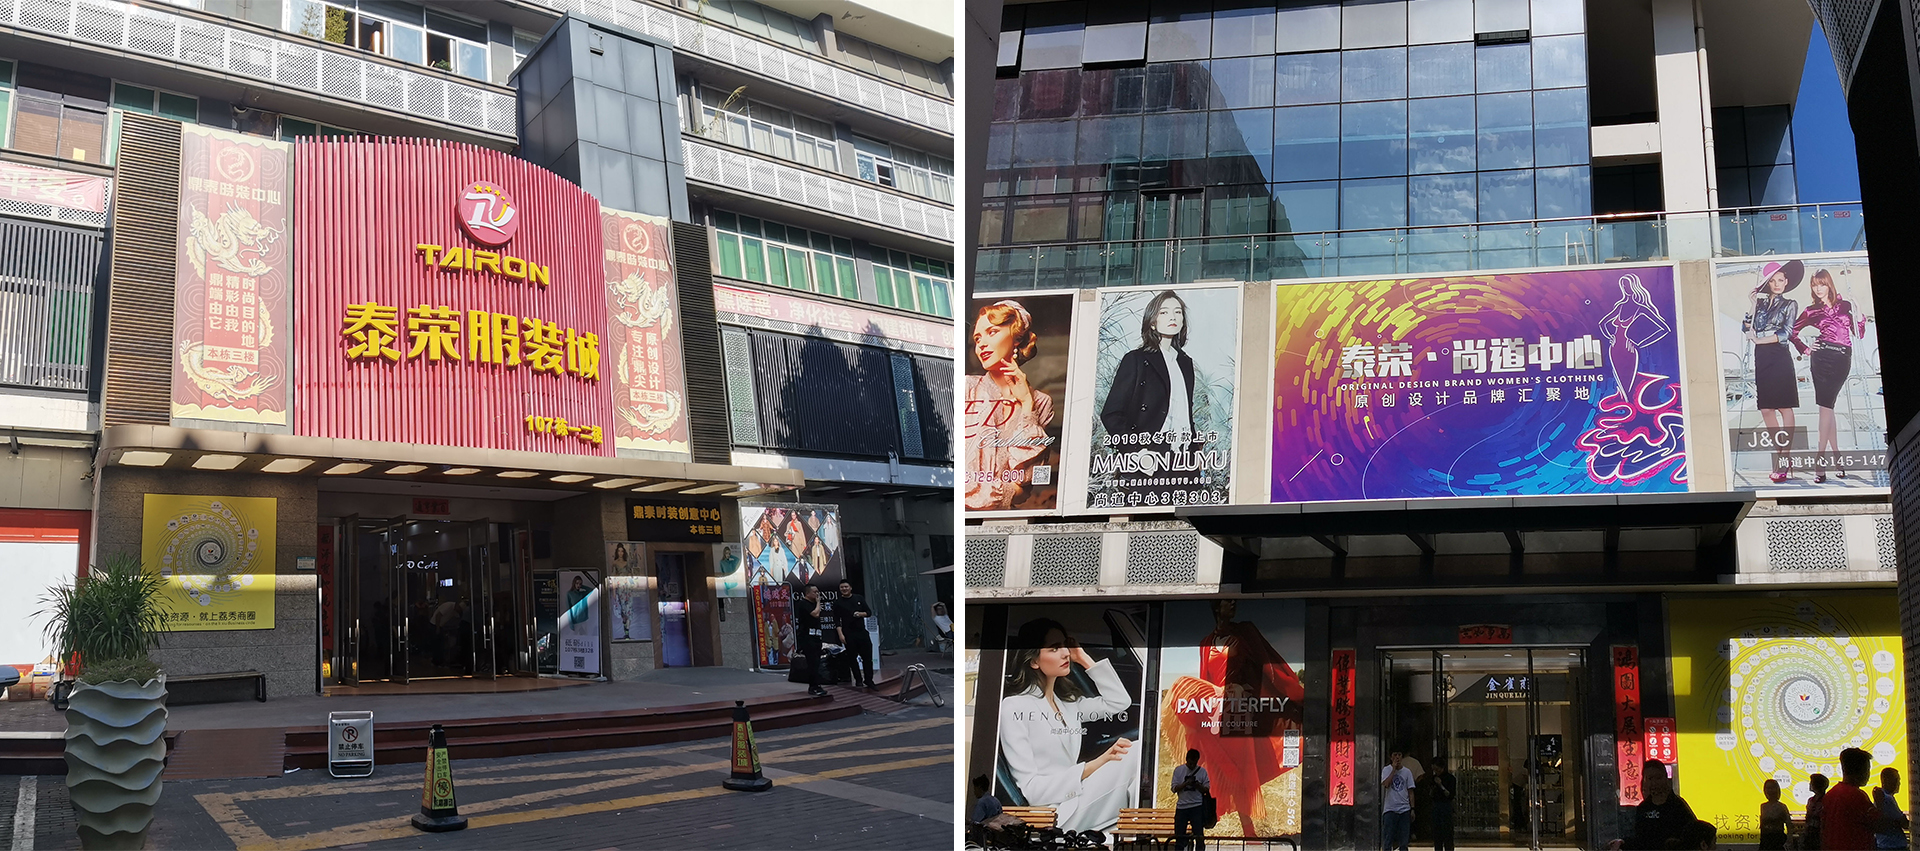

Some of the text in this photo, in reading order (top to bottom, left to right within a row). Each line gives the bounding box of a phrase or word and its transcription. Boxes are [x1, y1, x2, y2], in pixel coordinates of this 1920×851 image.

[416, 243, 549, 287] TAIRON
[208, 272, 223, 330] 鼎端由它
[224, 274, 240, 333] 精彩由我
[241, 277, 256, 348] 时尚目的地
[343, 301, 600, 382] 泰荣服装城
[206, 348, 256, 363] 本栋三楼
[645, 331, 661, 390] 原创设计
[1340, 373, 1605, 391] ORIGINAL DESIGN BRAND WOMEN'S CLOTHING
[1353, 386, 1591, 408] 原创设计品牌汇聚地
[1103, 430, 1219, 445] 2019秋冬新款上市
[1747, 430, 1790, 448] J&C
[1092, 449, 1228, 477] MAISON LUYU
[1778, 454, 1887, 468] 尚道中心145-147
[1094, 489, 1222, 508] 尚道中心3楼303
[1012, 710, 1130, 723] MENG RONG
